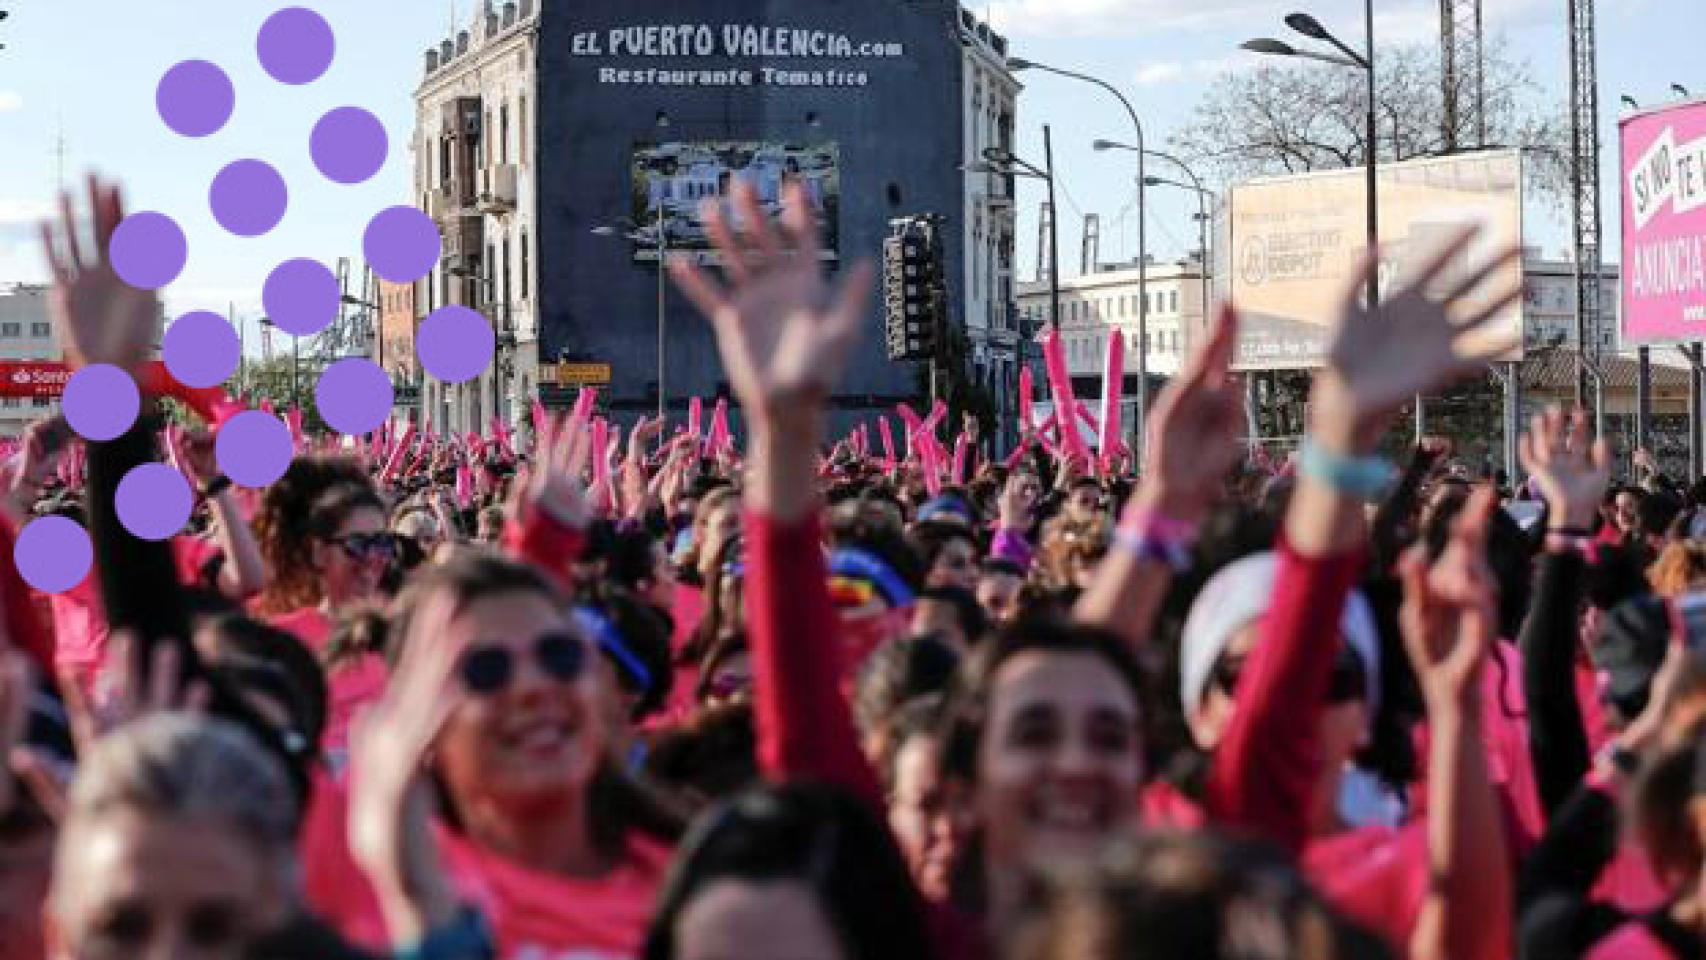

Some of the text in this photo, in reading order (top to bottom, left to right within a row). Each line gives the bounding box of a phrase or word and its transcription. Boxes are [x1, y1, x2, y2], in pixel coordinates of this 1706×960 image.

[572, 23, 903, 57] EL PUERTO VALENCIA.com
[599, 67, 752, 86] Restaurante
[1676, 153, 1696, 201] TE
